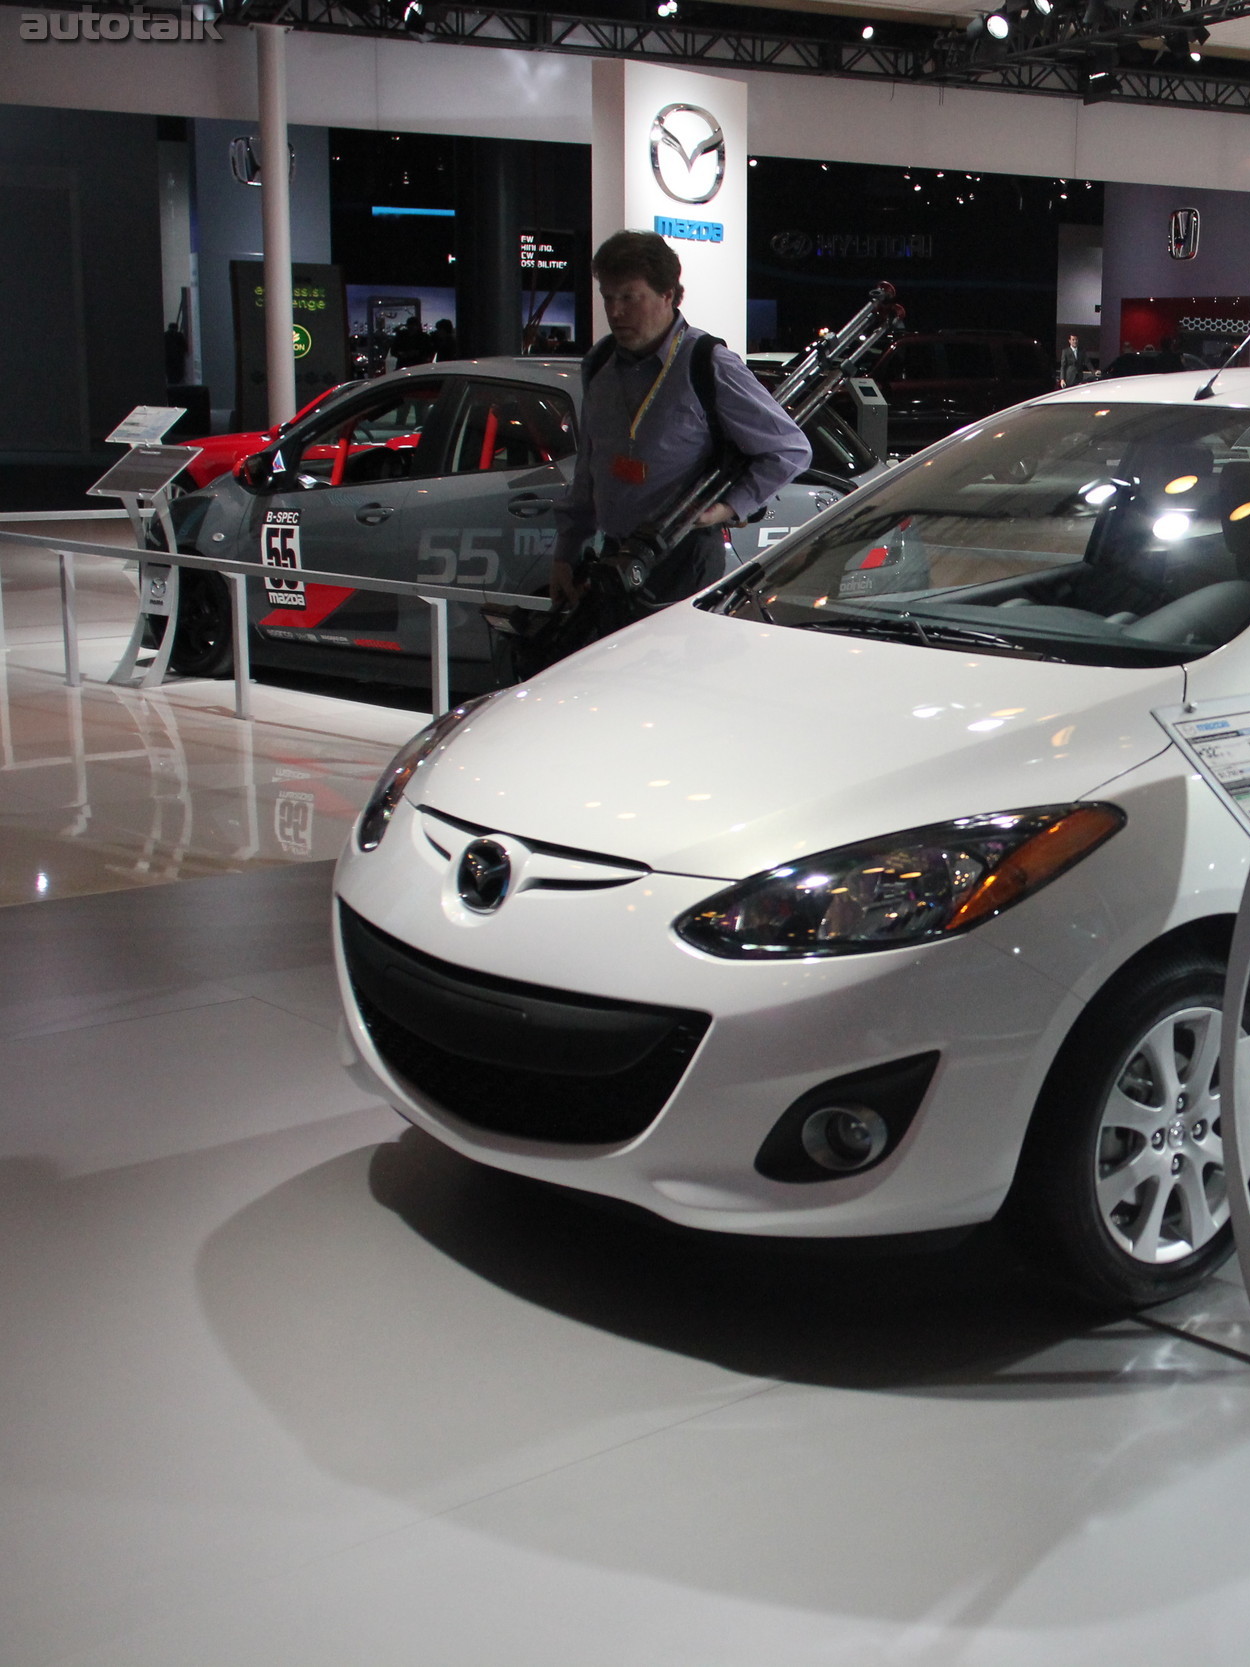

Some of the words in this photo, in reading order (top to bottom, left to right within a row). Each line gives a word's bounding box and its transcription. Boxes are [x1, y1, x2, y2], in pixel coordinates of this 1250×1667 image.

[654, 215, 724, 242] mazda
[266, 511, 300, 524] B-SPEC
[266, 527, 299, 590] 55
[416, 528, 503, 585] 55
[268, 591, 306, 607] mazda
